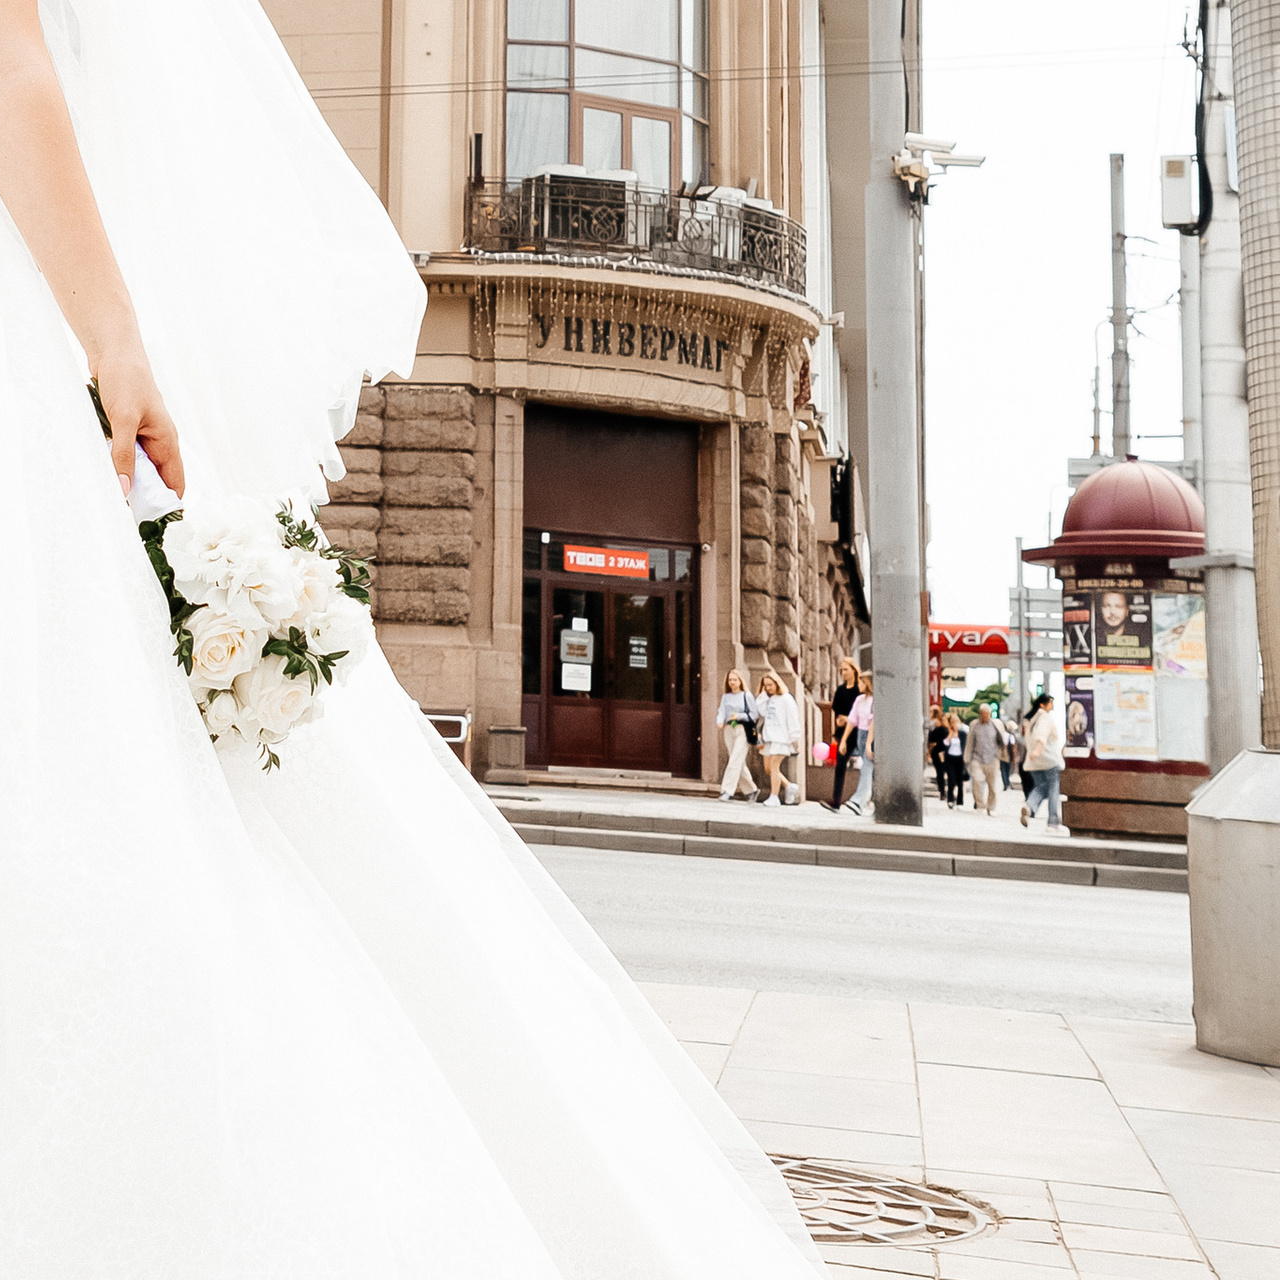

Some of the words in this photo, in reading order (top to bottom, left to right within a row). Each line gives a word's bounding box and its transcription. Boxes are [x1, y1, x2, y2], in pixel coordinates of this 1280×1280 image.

[535, 313, 729, 372] УНИВЕРМАГ
[608, 555, 616, 568] 2
[616, 556, 647, 570] ЭТАЖ
